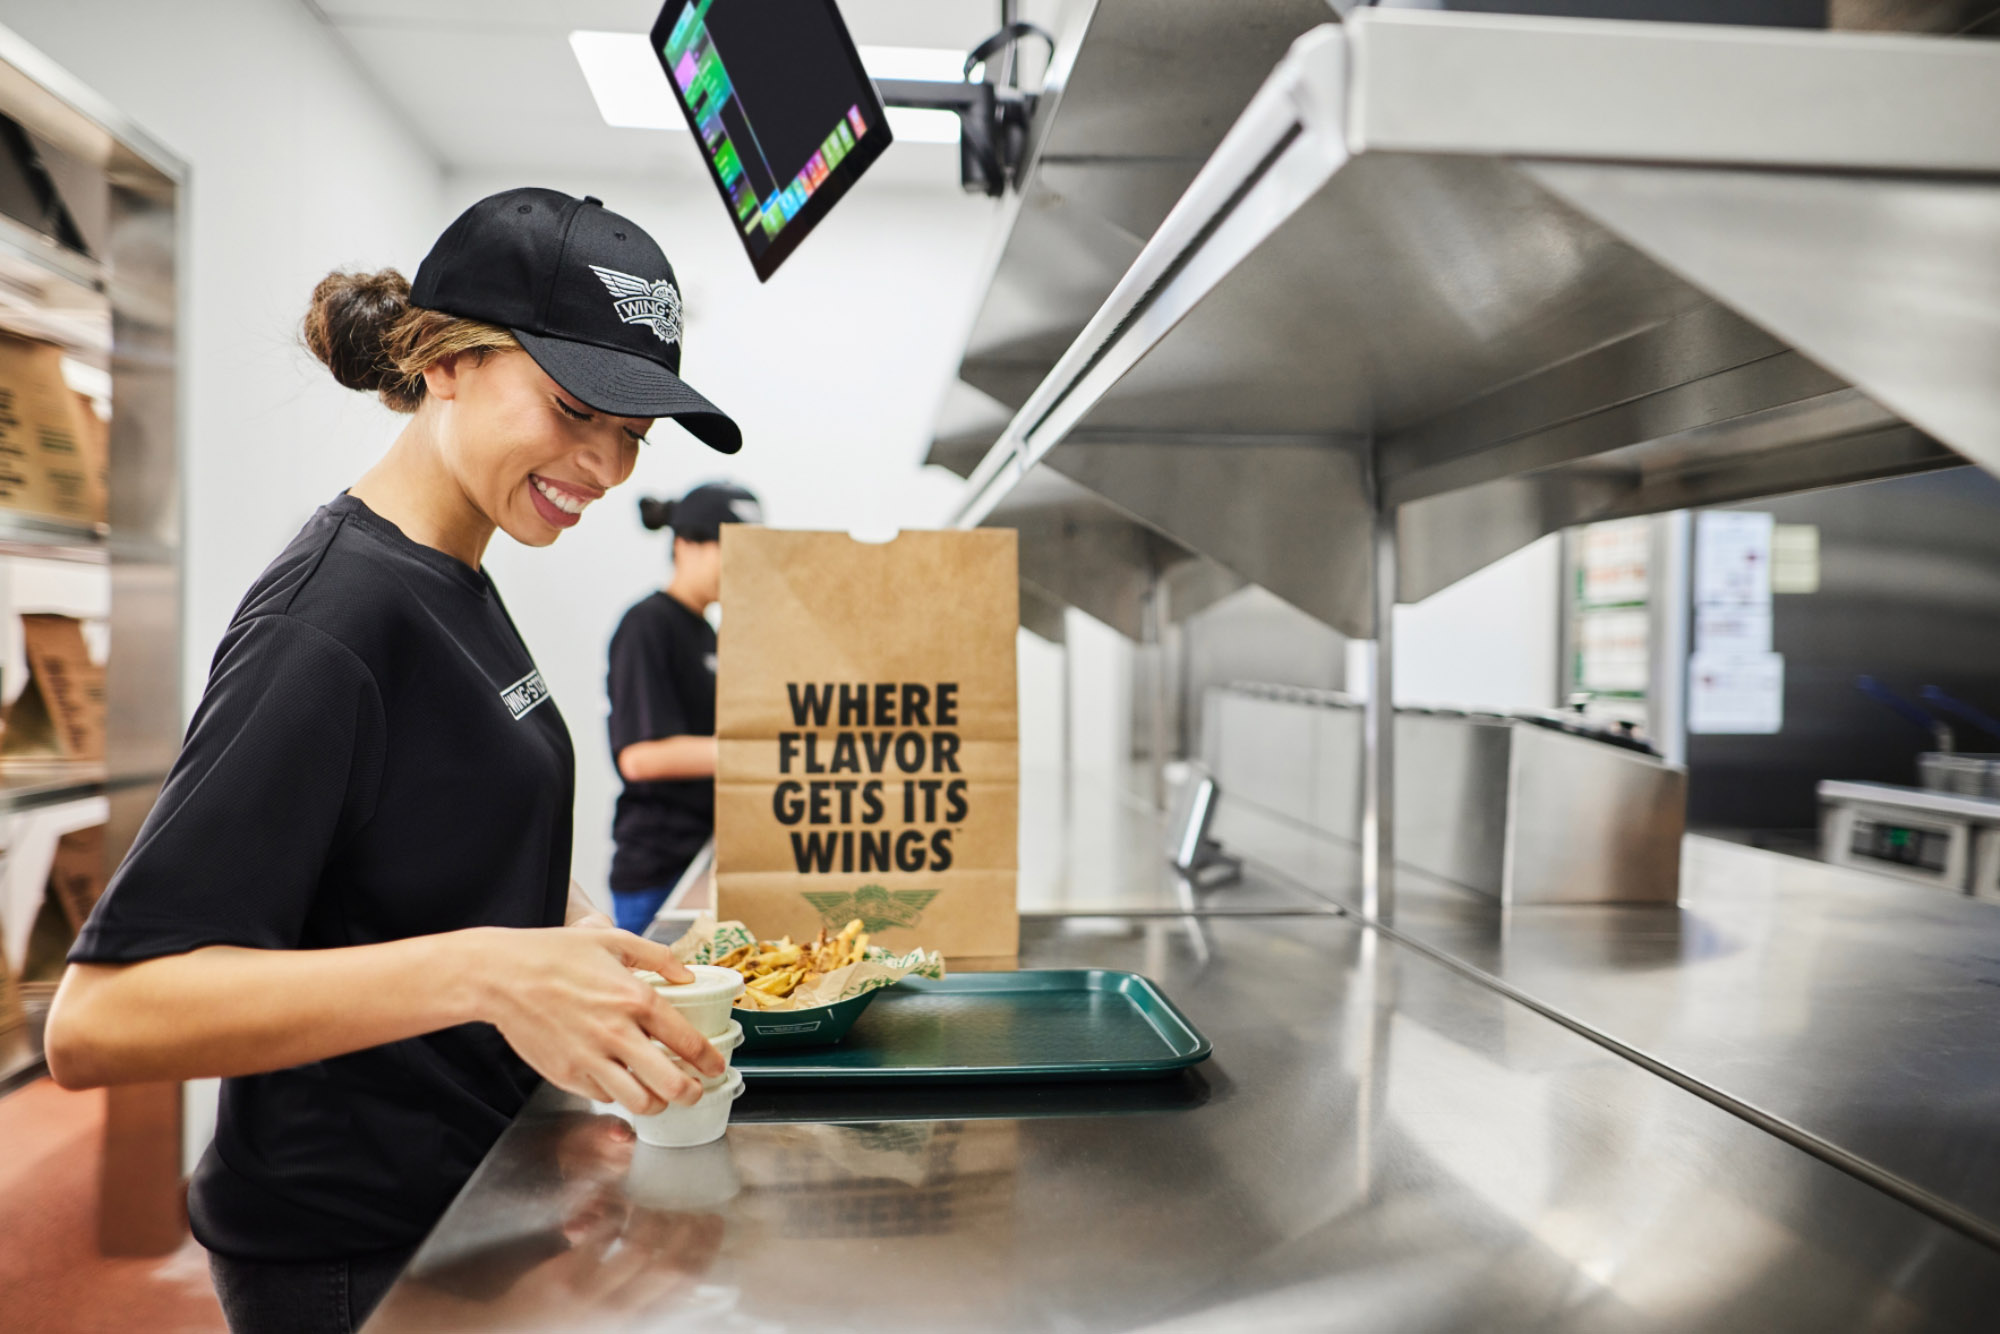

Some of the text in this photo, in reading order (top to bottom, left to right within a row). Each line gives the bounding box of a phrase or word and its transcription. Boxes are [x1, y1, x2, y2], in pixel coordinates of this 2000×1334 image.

[787, 683, 958, 727] WHERE
[779, 731, 961, 773] FLAVOR
[773, 779, 968, 825] GETS ITS
[791, 829, 953, 873] WINGS
